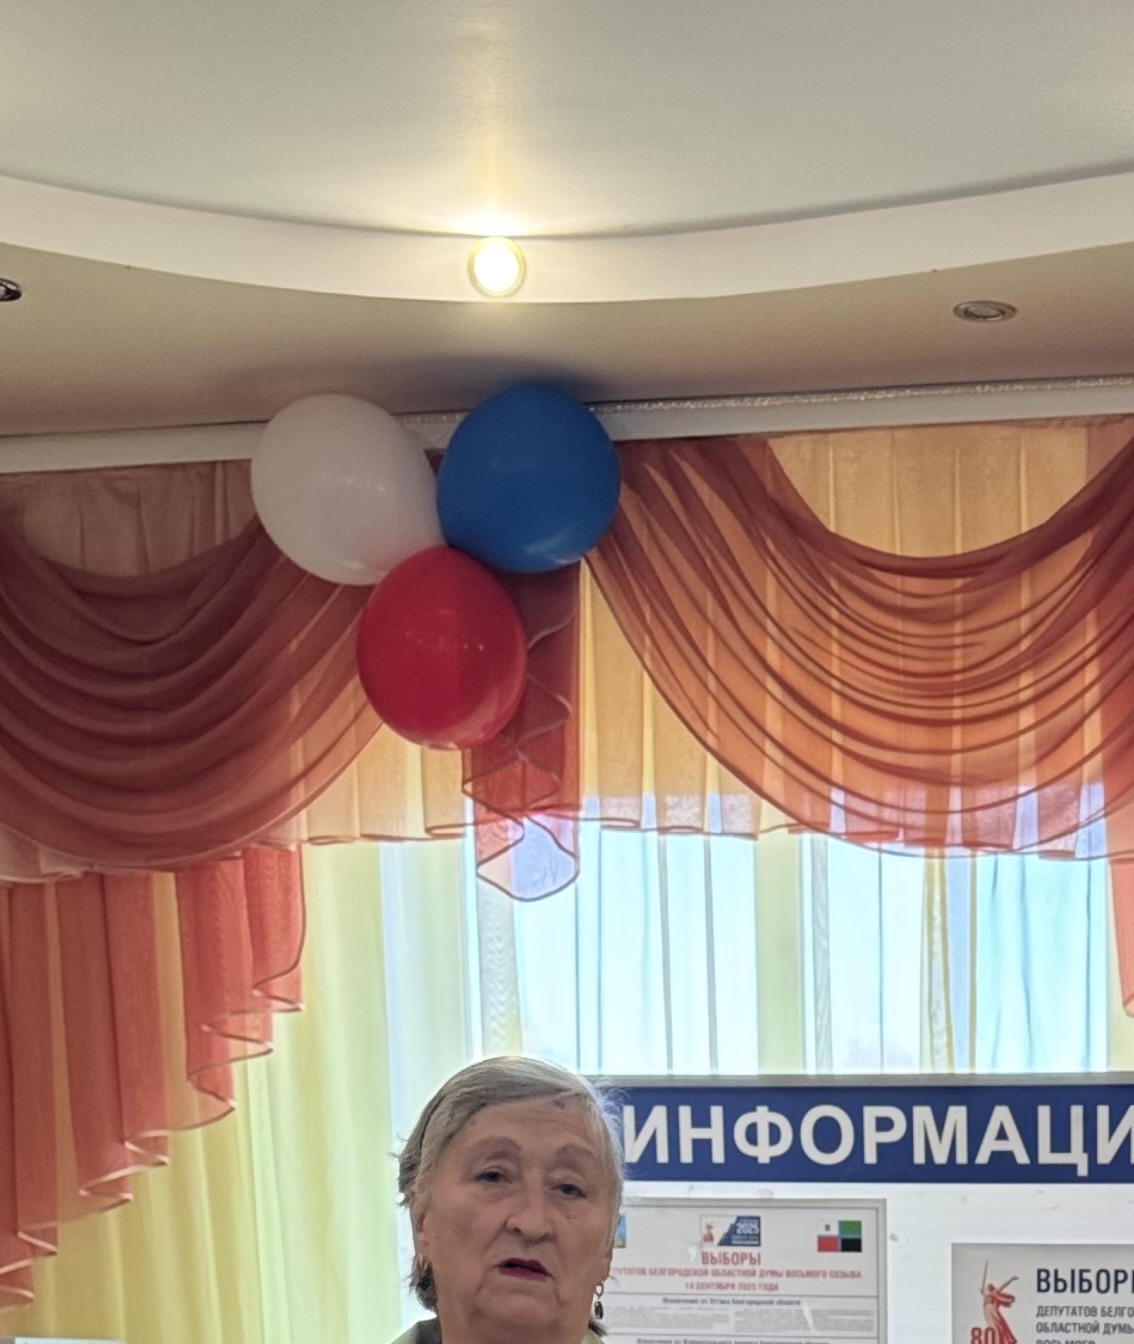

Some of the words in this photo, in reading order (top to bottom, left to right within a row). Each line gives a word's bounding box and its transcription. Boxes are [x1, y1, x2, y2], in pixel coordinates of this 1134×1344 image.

[701, 1251, 761, 1266] ВЫБОРЫ
[1036, 1305, 1098, 1319] ДЕПУТАТОВ
[1036, 1321, 1100, 1335] ОБЛАСТНОЙ
